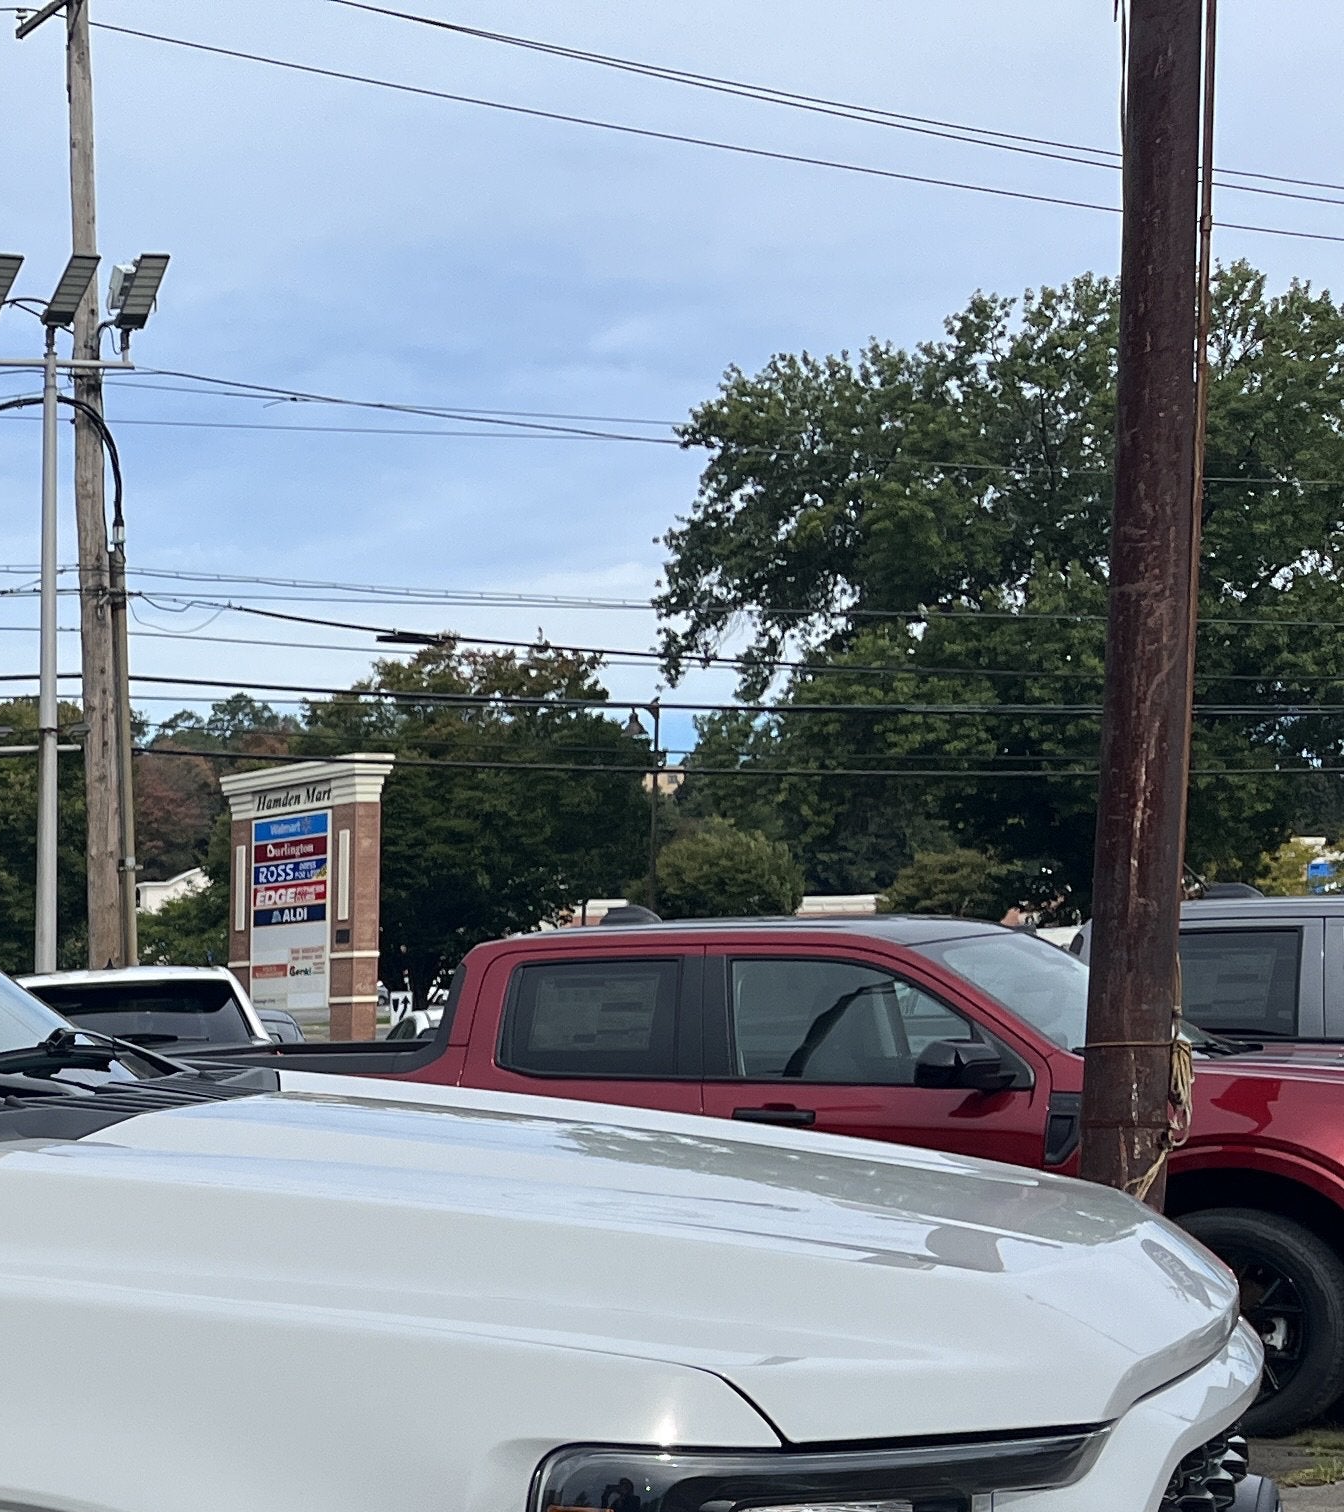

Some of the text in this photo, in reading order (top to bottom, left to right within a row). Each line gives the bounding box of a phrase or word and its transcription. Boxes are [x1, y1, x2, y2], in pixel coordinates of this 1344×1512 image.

[256, 786, 332, 811] Hamden Mart
[267, 842, 314, 858] Burlington
[259, 863, 294, 883] ROSS
[255, 888, 297, 906] EDGE
[282, 907, 308, 922] ALDI
